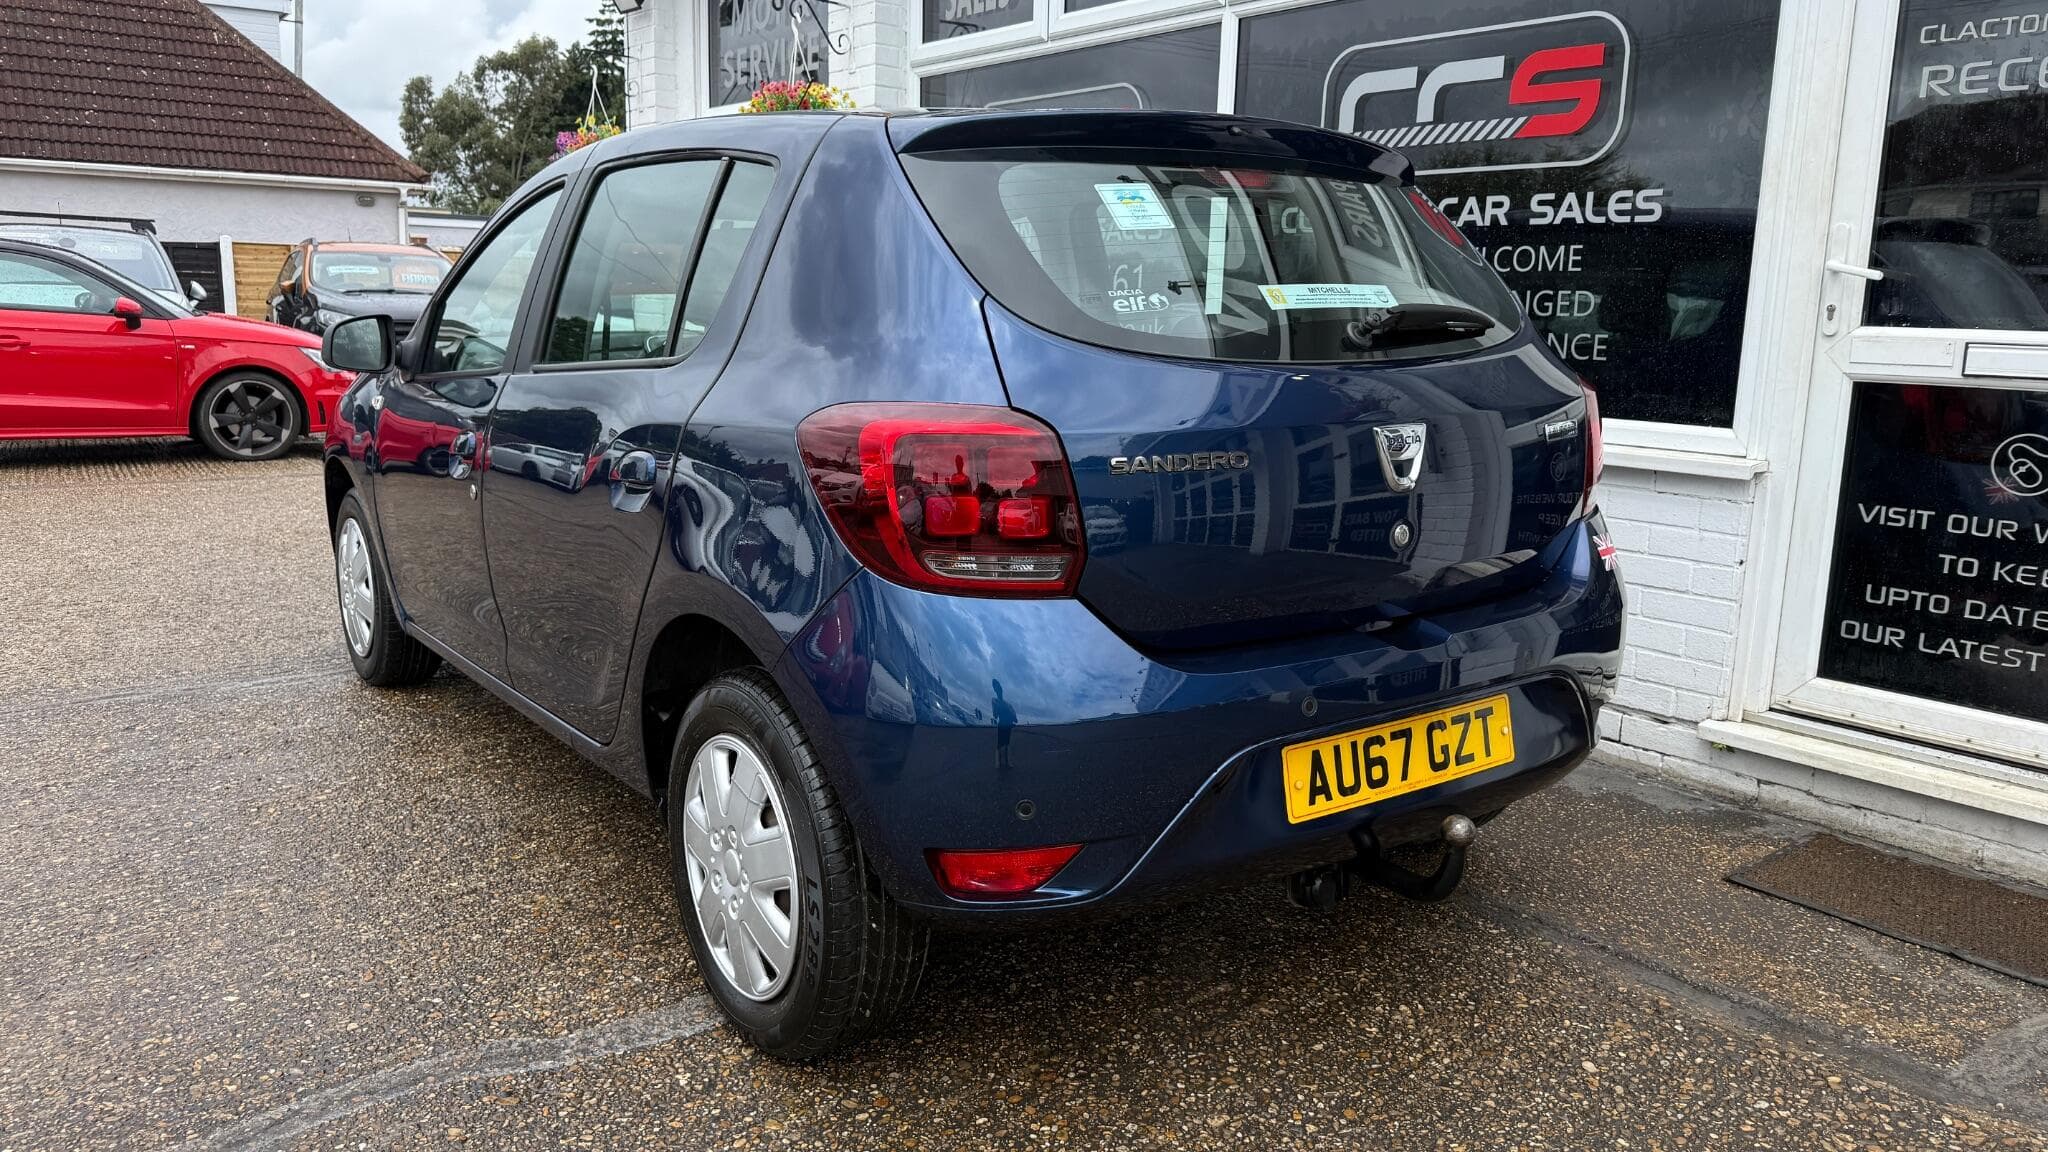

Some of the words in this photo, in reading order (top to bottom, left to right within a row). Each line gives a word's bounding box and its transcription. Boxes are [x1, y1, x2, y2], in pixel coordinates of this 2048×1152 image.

[1437, 195, 1511, 227] CAR
[1529, 188, 1664, 226] SALES
[1108, 288, 1144, 297] DACIA
[1113, 295, 1147, 312] elf
[1388, 434, 1421, 446] DACIA
[1110, 452, 1249, 476] SANDERO
[1858, 503, 1936, 530] VISIT
[1946, 513, 2019, 541] OUR
[1938, 553, 1979, 578] TO
[1865, 583, 1950, 615] UPTO
[1964, 599, 2048, 631] DATE
[1840, 619, 1906, 648] OUR
[1918, 632, 2046, 672] LATEST
[1308, 726, 1413, 807] AU67
[1426, 706, 1494, 773] GZT
